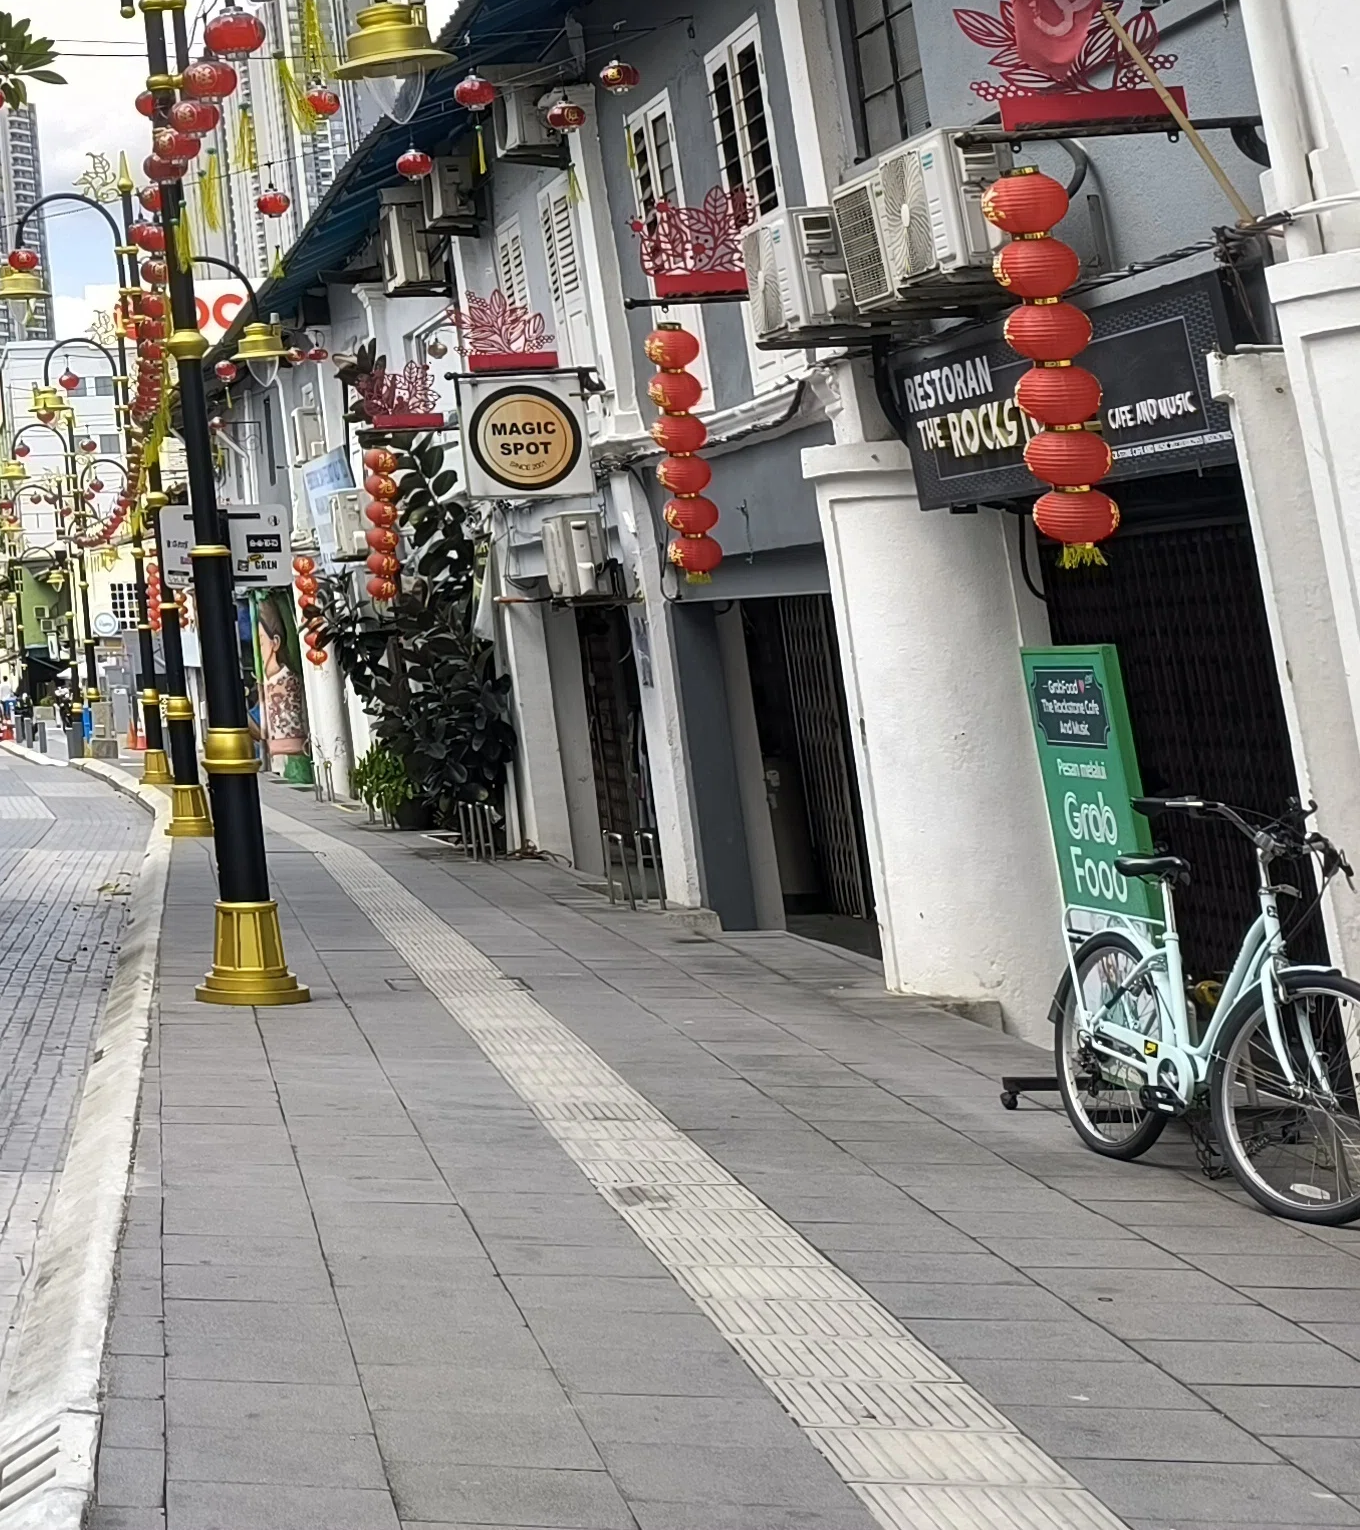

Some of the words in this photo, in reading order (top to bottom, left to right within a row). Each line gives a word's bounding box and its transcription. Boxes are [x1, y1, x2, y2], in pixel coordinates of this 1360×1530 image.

[904, 355, 993, 413] RESTORAN
[491, 422, 557, 436] MAGIC
[917, 417, 946, 451] THE
[947, 398, 1042, 458] ROCKST
[1107, 405, 1137, 430] CAFE
[1136, 398, 1158, 425] AND
[1158, 391, 1198, 419] MUSIC
[500, 442, 552, 456] SPOT
[509, 460, 531, 471] SINCE
[1064, 791, 1118, 846] Grab
